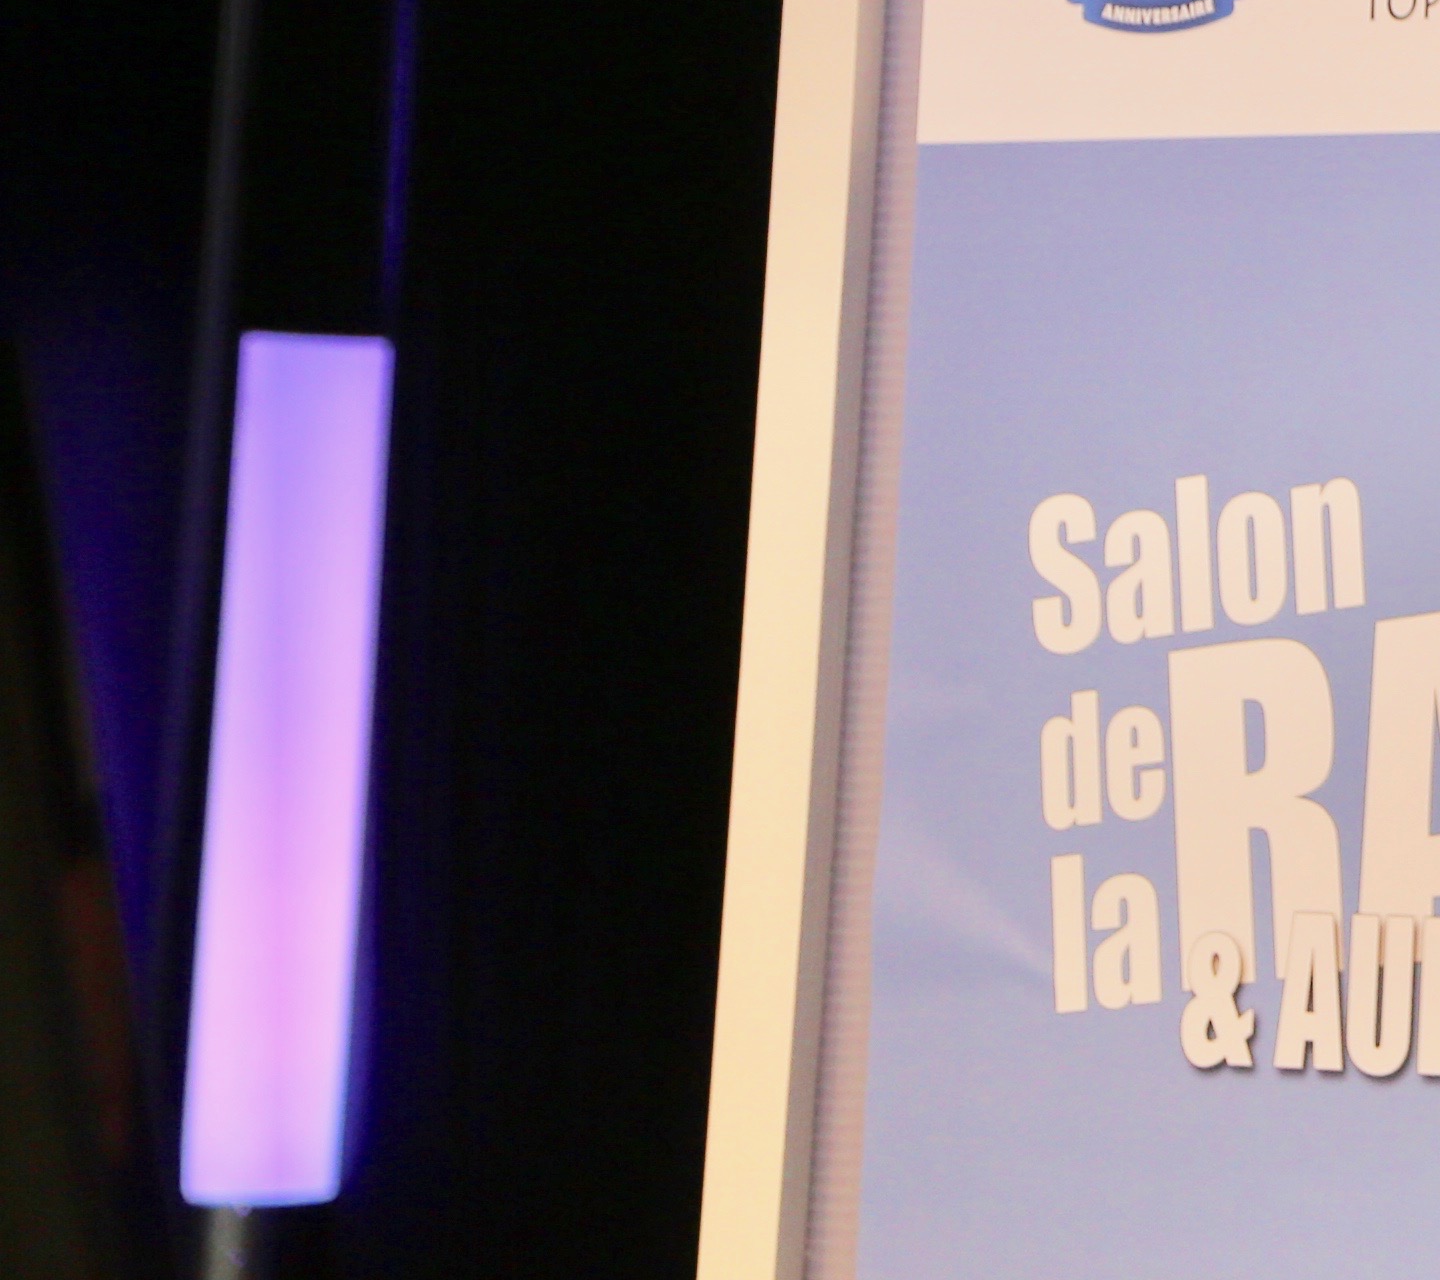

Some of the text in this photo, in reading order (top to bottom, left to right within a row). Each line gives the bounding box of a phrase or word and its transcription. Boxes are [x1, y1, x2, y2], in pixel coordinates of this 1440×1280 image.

[1028, 475, 1365, 654] Salon
[1040, 689, 1165, 830] de
[1050, 853, 1161, 1014] la
[1180, 930, 1254, 1070] &
